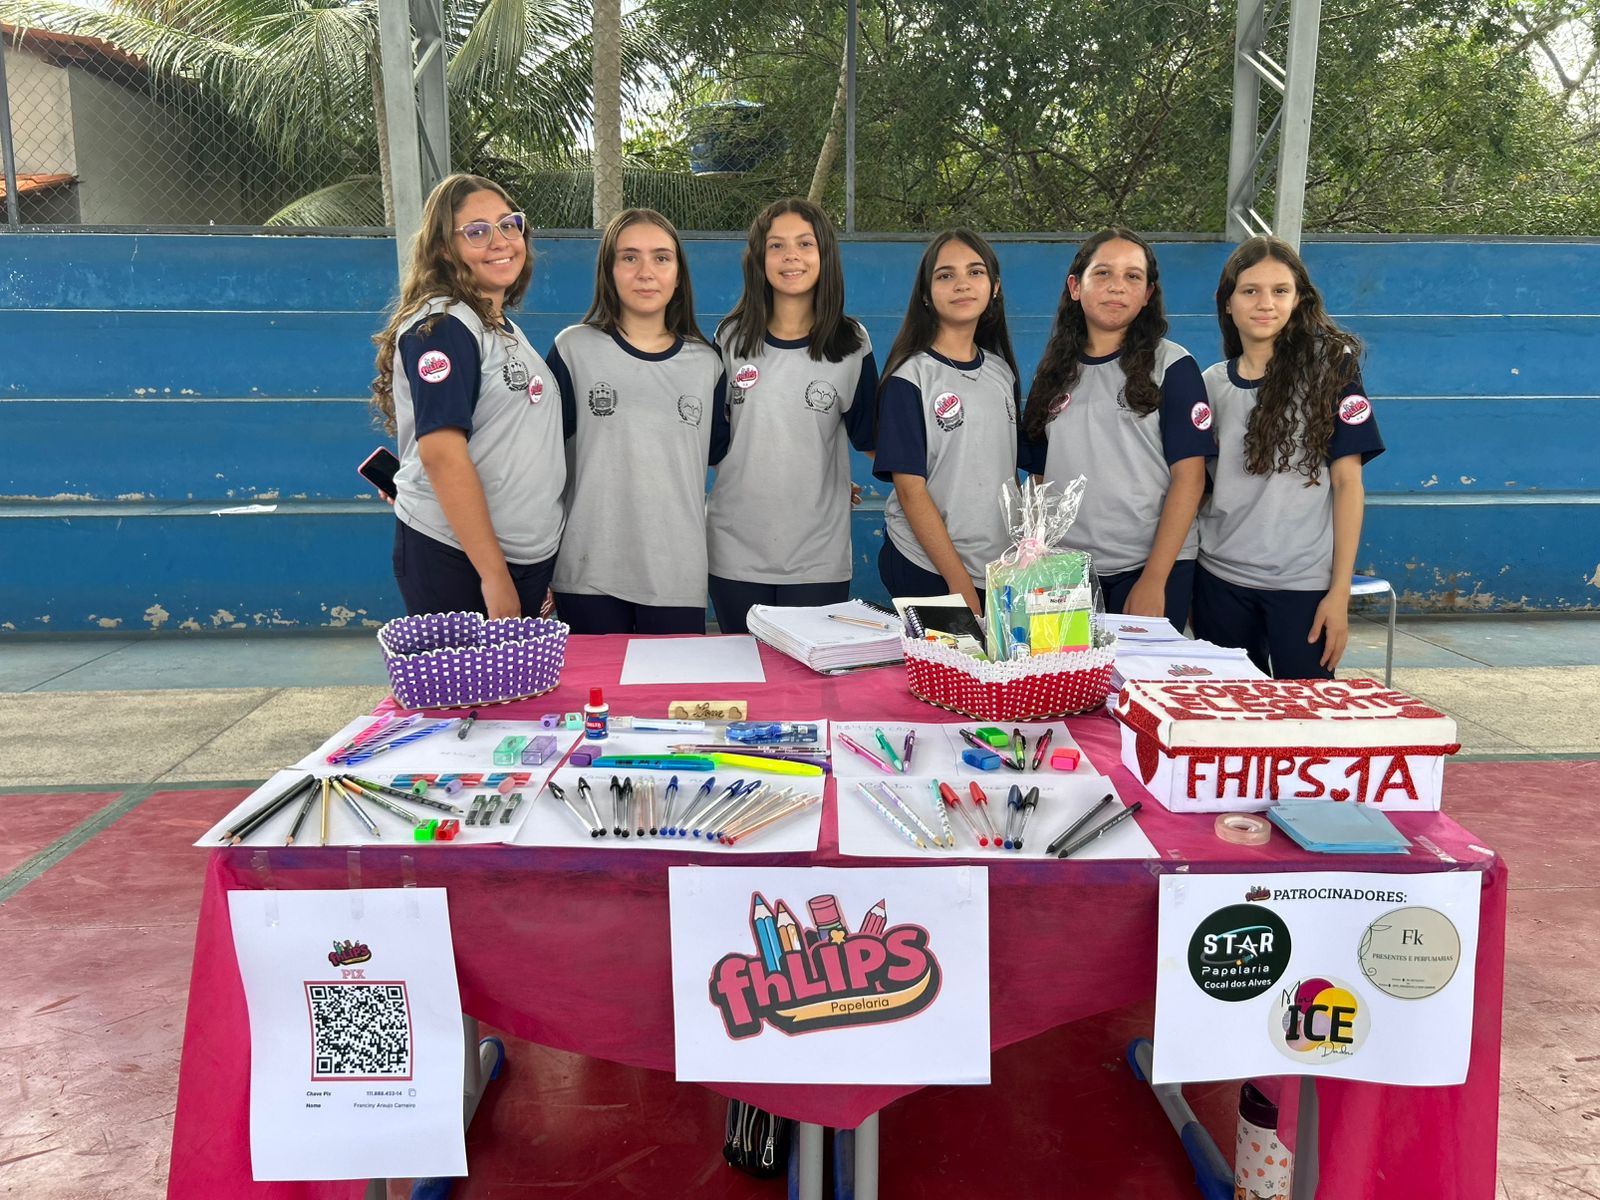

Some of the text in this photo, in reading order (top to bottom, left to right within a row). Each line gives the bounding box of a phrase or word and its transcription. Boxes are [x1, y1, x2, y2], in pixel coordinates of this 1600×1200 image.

[1273, 888, 1408, 903] PATROCINADORES:
[1203, 932, 1274, 957] STAR
[1401, 928, 1424, 946] Fk
[1372, 953, 1408, 961] PRESENTES
[341, 969, 366, 979] PIX
[1201, 964, 1270, 977] Papelaria
[1204, 978, 1272, 989] Cocal dos Alves
[830, 997, 890, 1014] Papelaria
[1285, 1003, 1356, 1044] ICE
